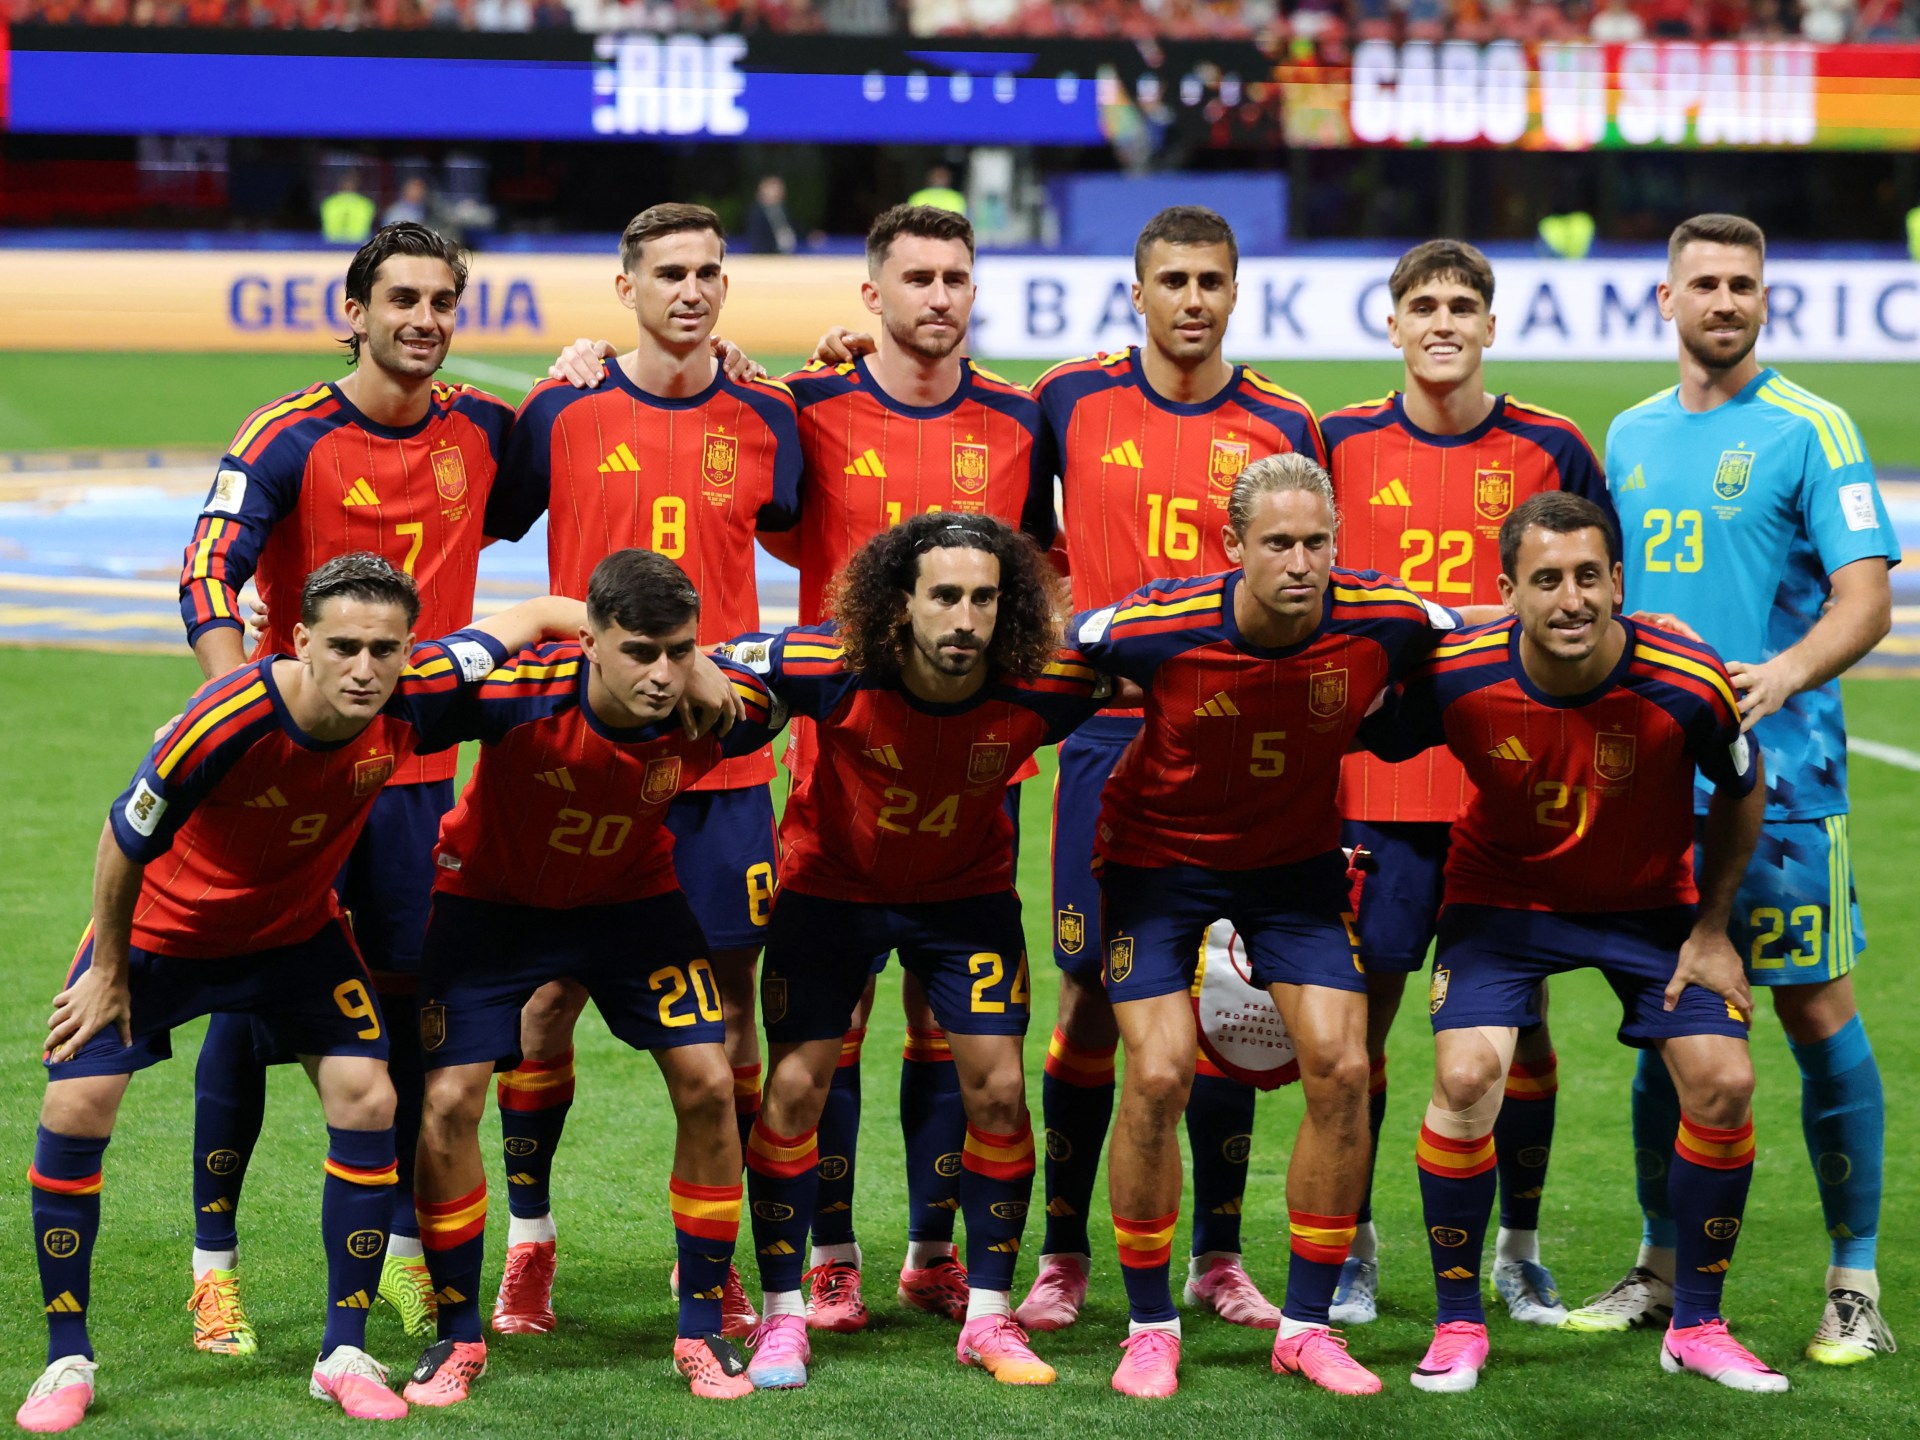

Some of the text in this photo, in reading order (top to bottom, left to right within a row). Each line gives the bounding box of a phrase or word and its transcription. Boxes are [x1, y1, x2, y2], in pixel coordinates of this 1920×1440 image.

[229, 276, 541, 333] GEIA
[1024, 278, 1305, 338] BAK
[1519, 280, 1920, 342] AMRIC
[395, 522, 423, 576] 7
[652, 496, 686, 560] 8
[1146, 493, 1199, 561] 16
[1643, 508, 1703, 573] 23
[1400, 529, 1473, 593] 22
[1249, 731, 1287, 777] 5
[287, 813, 328, 847] 9
[548, 808, 633, 857] 20
[877, 786, 960, 838] 24
[1534, 781, 1588, 838] 21
[746, 861, 774, 927] 8
[1751, 904, 1822, 969] 23
[332, 978, 381, 1041] 9
[648, 958, 723, 1028] 20
[1215, 1010, 1280, 1025] FEDERACI
[1244, 1003, 1275, 1013] REAL
[1218, 1034, 1234, 1043] DE
[51, 1233, 71, 1242] RF
[51, 1242, 71, 1251] EF
[355, 1235, 378, 1243] RF
[355, 1243, 377, 1252] EF
